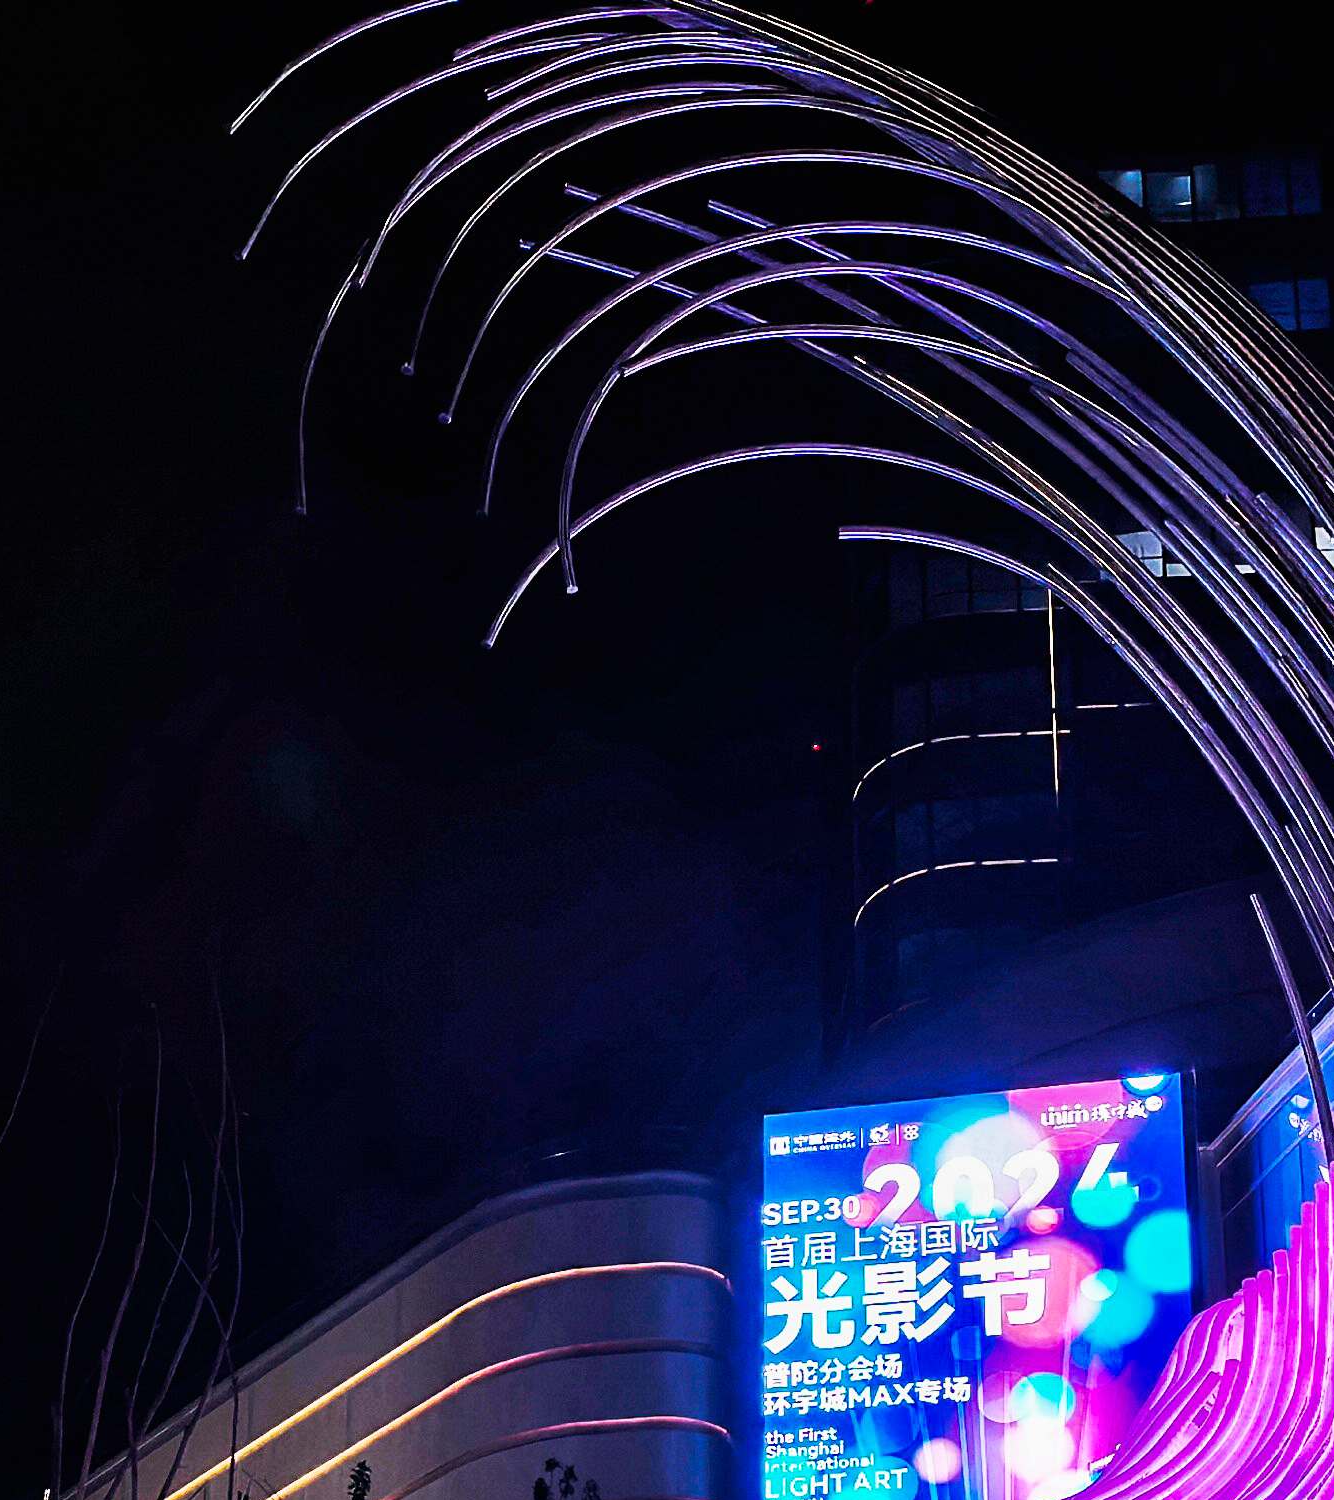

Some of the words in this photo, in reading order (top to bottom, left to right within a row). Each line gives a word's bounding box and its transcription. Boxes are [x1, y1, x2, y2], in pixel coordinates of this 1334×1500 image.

[762, 1195, 861, 1226] SEP.30
[762, 1217, 1000, 1271] 首届上海国际
[763, 1248, 1052, 1355] 光影节
[763, 1352, 904, 1389] 普陀分会场
[765, 1430, 795, 1445] the
[798, 1426, 838, 1443] First
[765, 1440, 844, 1460] Shanghai
[765, 1472, 848, 1499] LIGHT
[853, 1467, 909, 1492] ART
